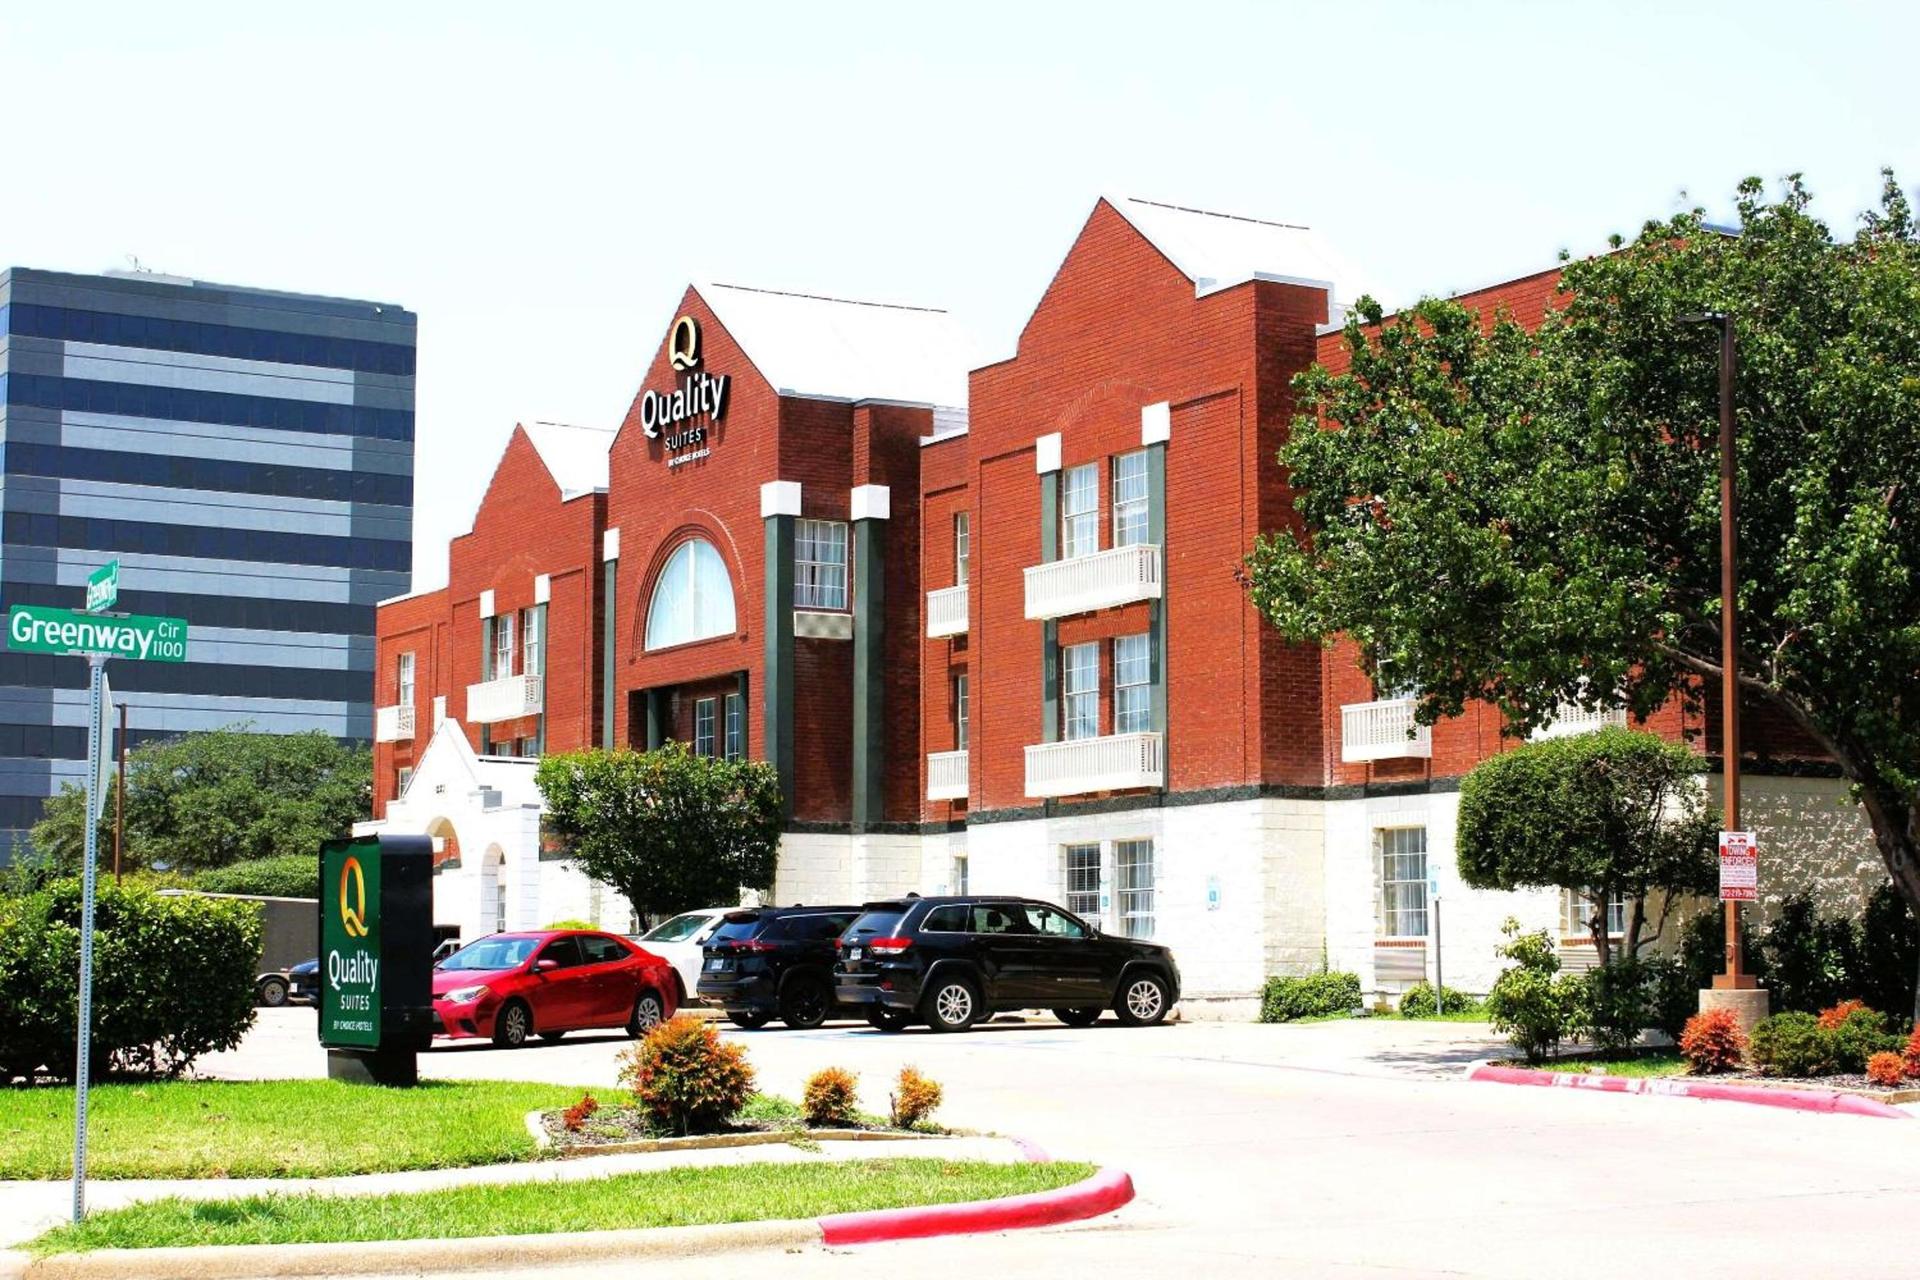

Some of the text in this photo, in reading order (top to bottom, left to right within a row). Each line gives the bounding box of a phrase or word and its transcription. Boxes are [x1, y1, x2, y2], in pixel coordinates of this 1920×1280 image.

[669, 316, 698, 370] Q
[641, 373, 725, 438] Quality
[664, 428, 701, 451] SUITES
[12, 611, 154, 660] Greenway
[153, 641, 183, 657] 1100
[158, 622, 179, 639] Cir
[340, 856, 369, 937] Q
[328, 949, 378, 993] Quality
[340, 994, 370, 1010] SUITES
